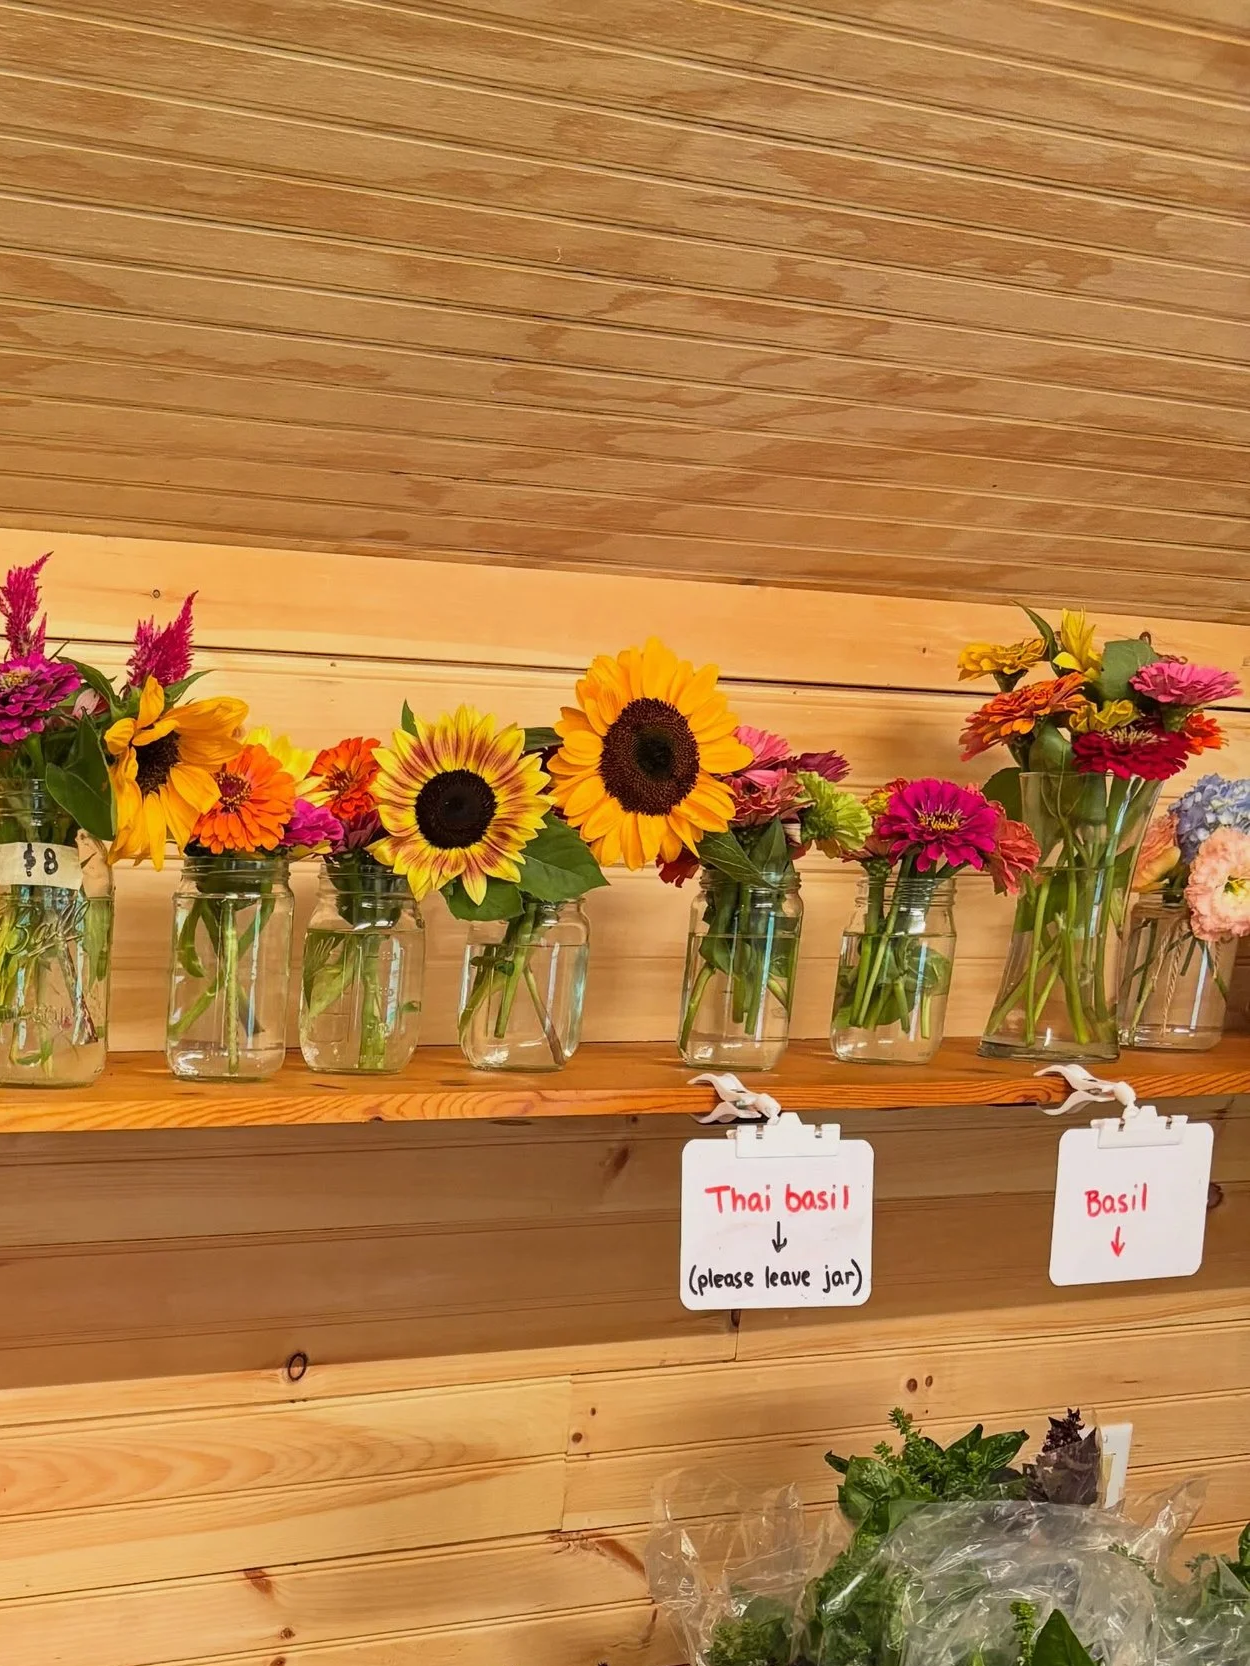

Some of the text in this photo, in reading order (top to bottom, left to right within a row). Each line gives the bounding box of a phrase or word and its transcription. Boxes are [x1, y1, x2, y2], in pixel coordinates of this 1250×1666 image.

[704, 1183, 849, 1214] Thai basil
[1084, 1182, 1148, 1218] Basil
[688, 1258, 863, 1297] (please leave jar)
